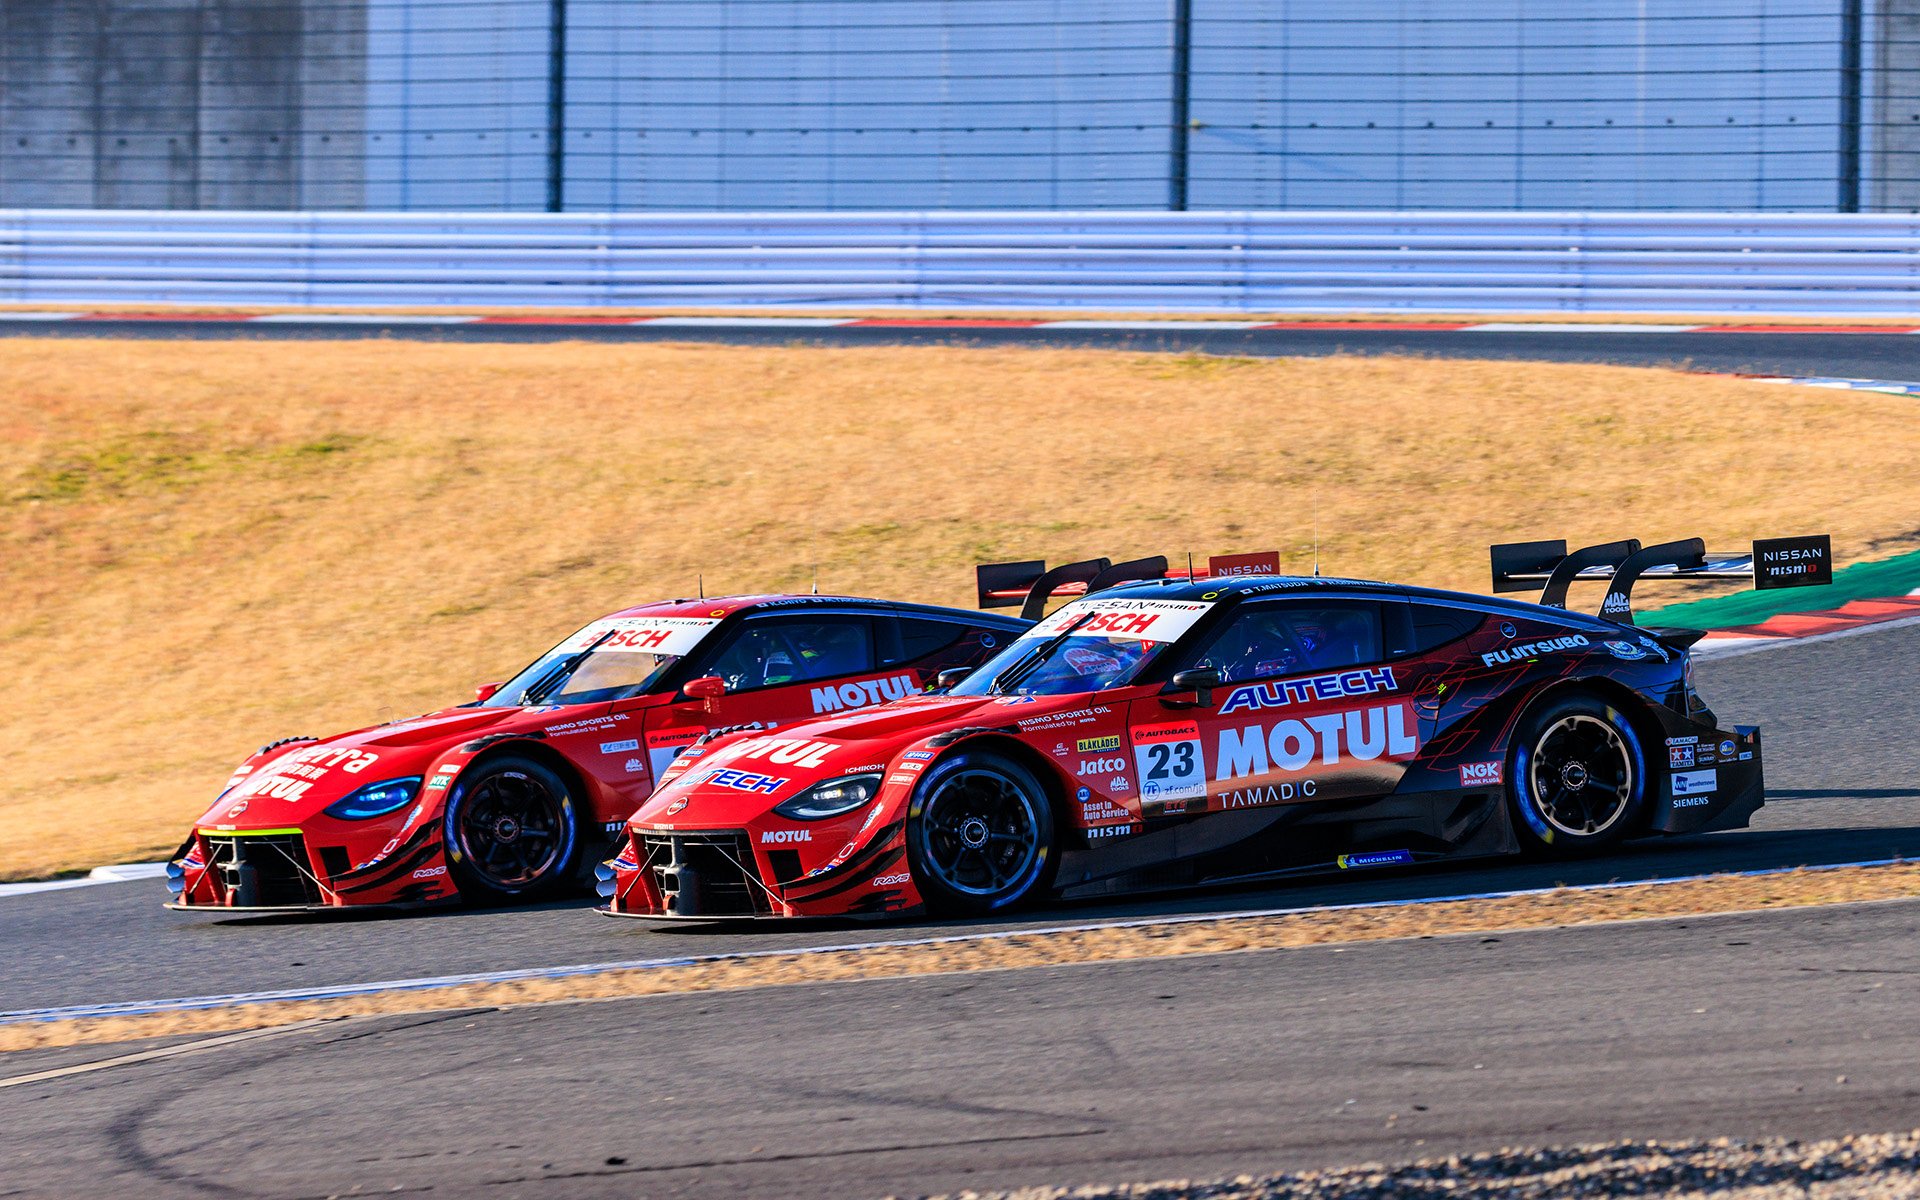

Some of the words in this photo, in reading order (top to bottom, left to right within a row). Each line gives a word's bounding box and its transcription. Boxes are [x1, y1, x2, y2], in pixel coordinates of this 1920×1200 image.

[1763, 548, 1822, 562] NISSAN
[1218, 563, 1273, 576] NISSAN
[1604, 592, 1629, 608] MAC
[1604, 605, 1630, 614] TOOLS
[1053, 612, 1161, 634] BOSCH
[578, 629, 674, 649] BOSCH
[1480, 634, 1590, 668] FUJITSUBO
[810, 675, 923, 714] MOTUL
[1217, 666, 1399, 716] AUTECH
[544, 722, 576, 733] NISMO
[576, 715, 614, 727] SPORTS
[614, 713, 631, 721] OIL
[1017, 716, 1052, 727] NISMO
[1052, 708, 1094, 721] SPORTS
[1093, 706, 1112, 714] OIL
[1022, 721, 1065, 733] Formulated
[1066, 720, 1076, 728] by
[1145, 727, 1196, 738] AUTOBACS
[659, 731, 705, 742] AUTOBACS
[1215, 703, 1417, 782] MOTUL
[1078, 737, 1120, 751] BLÅKLÄDER
[1076, 757, 1126, 776] Jatco
[1147, 741, 1195, 780] 23
[845, 763, 885, 774] ICHIKOH
[1462, 762, 1499, 779] NGK
[1110, 776, 1129, 788] MAC
[1218, 780, 1317, 809] TAMADIC
[1083, 801, 1104, 812] Asset
[1104, 800, 1112, 809] In
[1673, 796, 1709, 808] SIEMENS
[1083, 810, 1101, 820] Auto
[1101, 807, 1129, 819] Service
[761, 830, 812, 843] MOTUL
[1087, 824, 1143, 839] nismo
[1358, 854, 1403, 864] MICHELIN
[413, 865, 447, 879] RAYS
[873, 872, 910, 887] RAYS
